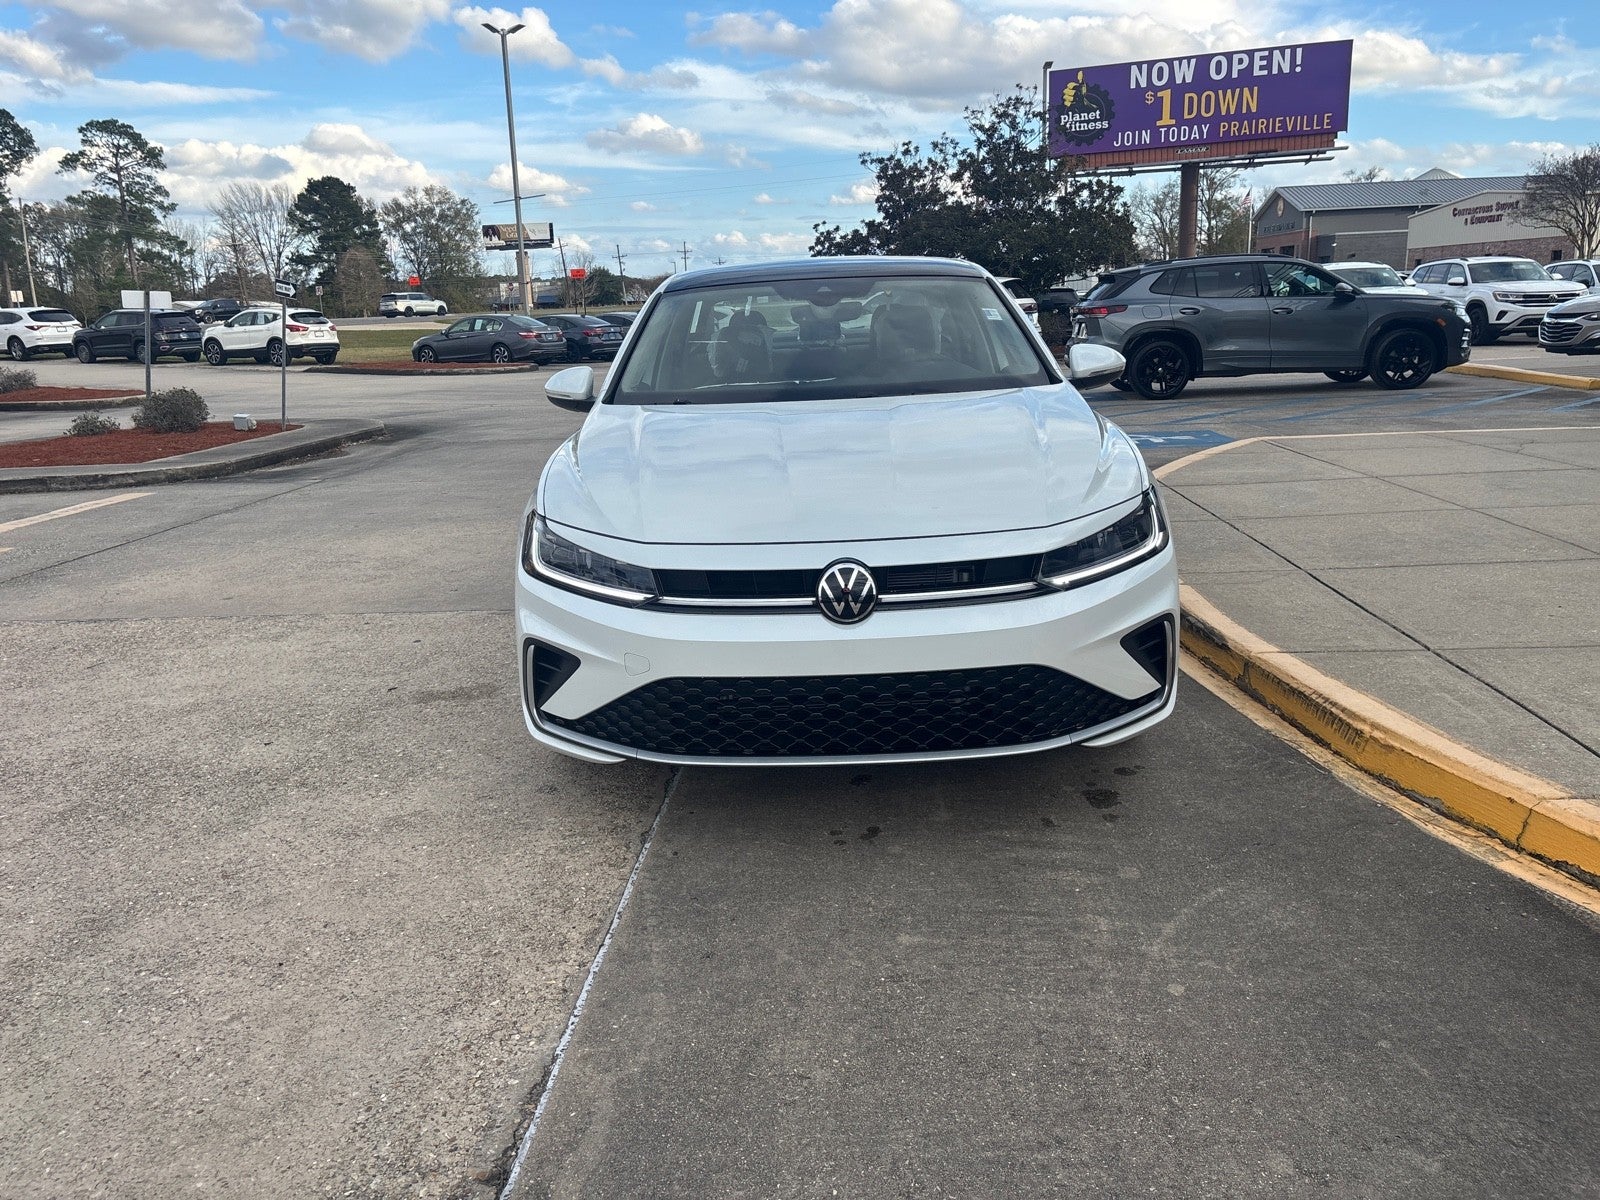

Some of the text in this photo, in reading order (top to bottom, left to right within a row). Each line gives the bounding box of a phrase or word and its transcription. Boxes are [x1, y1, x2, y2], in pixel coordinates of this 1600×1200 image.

[1130, 47, 1304, 89] NOW OPEN!
[1060, 109, 1101, 125] planet
[1184, 86, 1259, 120] DOWN
[1066, 120, 1109, 132] fitness
[1113, 112, 1333, 147] JOIN TODAY PRAIRIEVILLE
